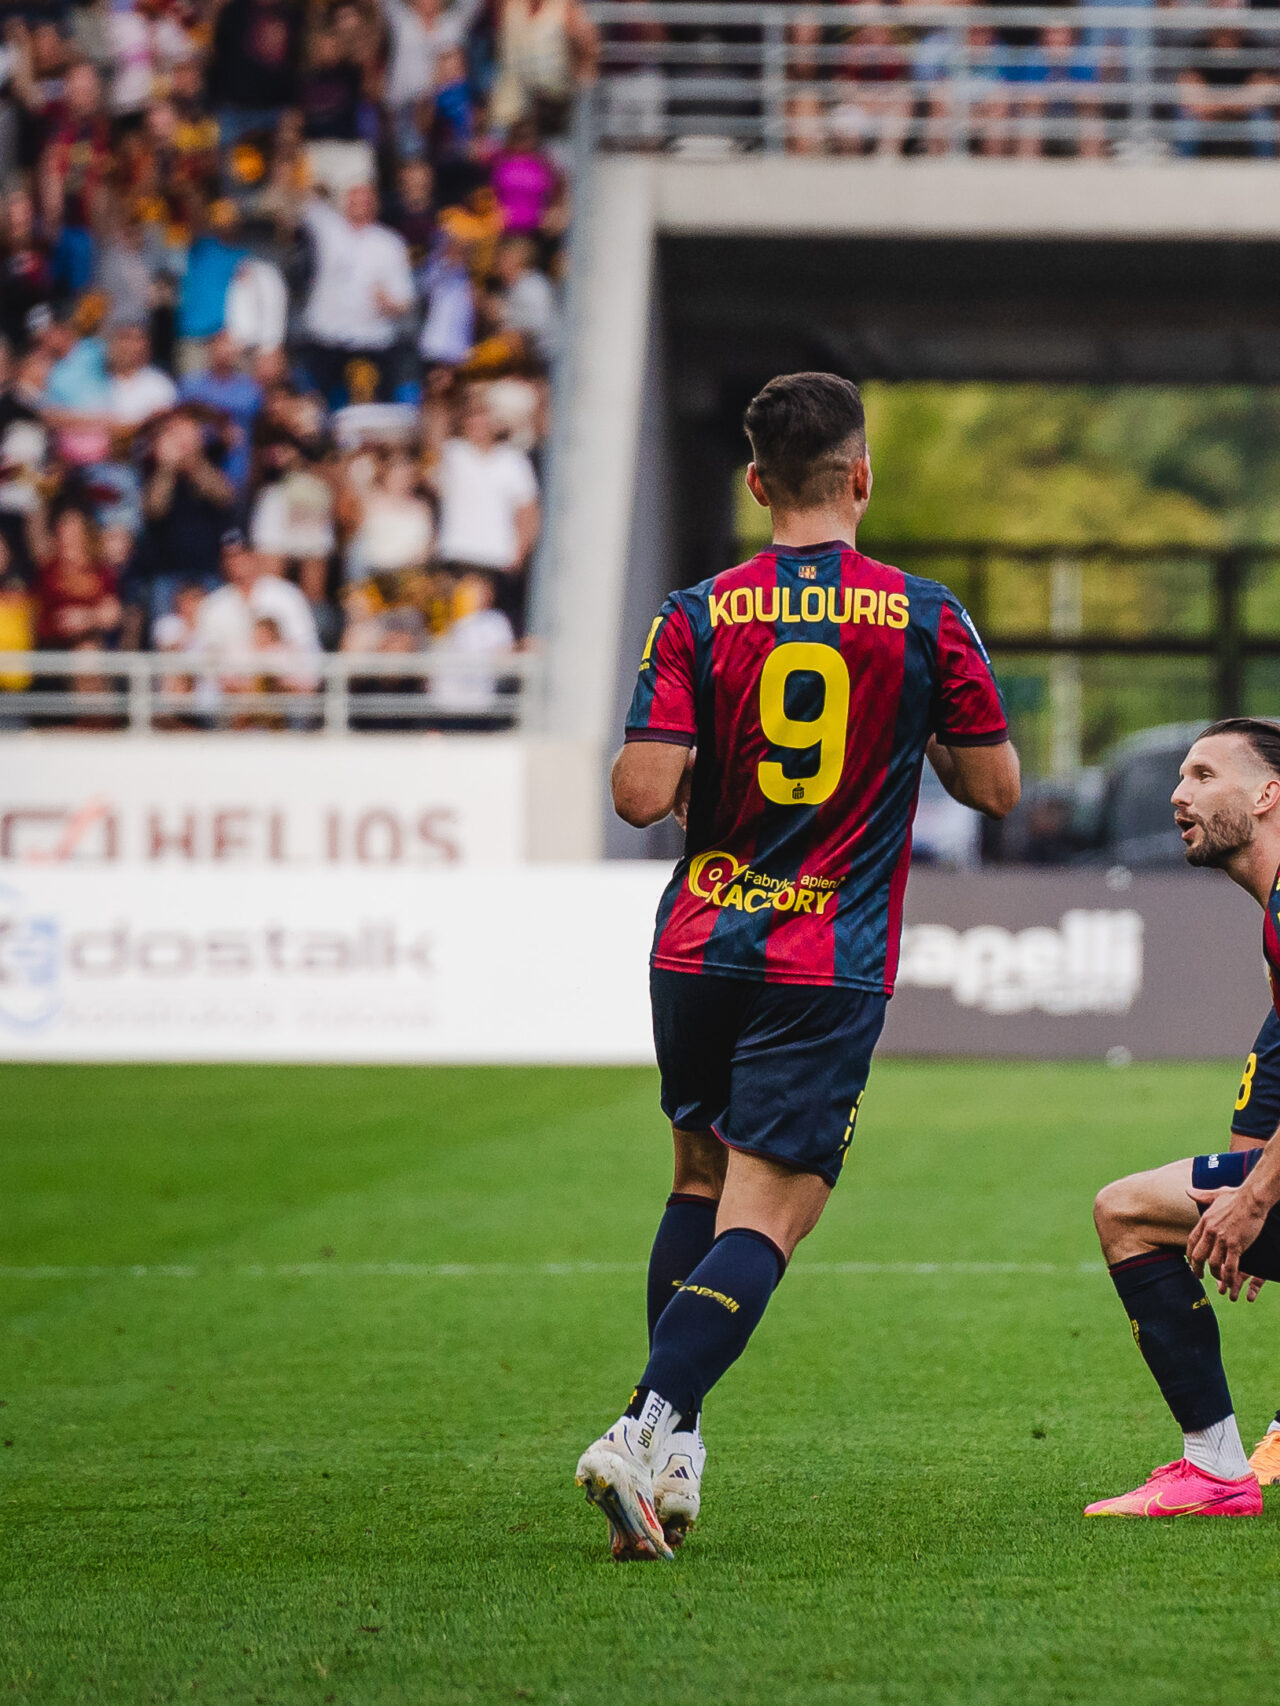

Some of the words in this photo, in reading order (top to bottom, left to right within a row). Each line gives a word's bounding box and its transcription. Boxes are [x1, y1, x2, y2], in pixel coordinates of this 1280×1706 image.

[708, 586, 910, 629] KOULOURIS
[757, 642, 850, 805] 9
[147, 803, 463, 864] HELIOS
[68, 916, 437, 978] dostalk
[902, 909, 1144, 1006] apelli
